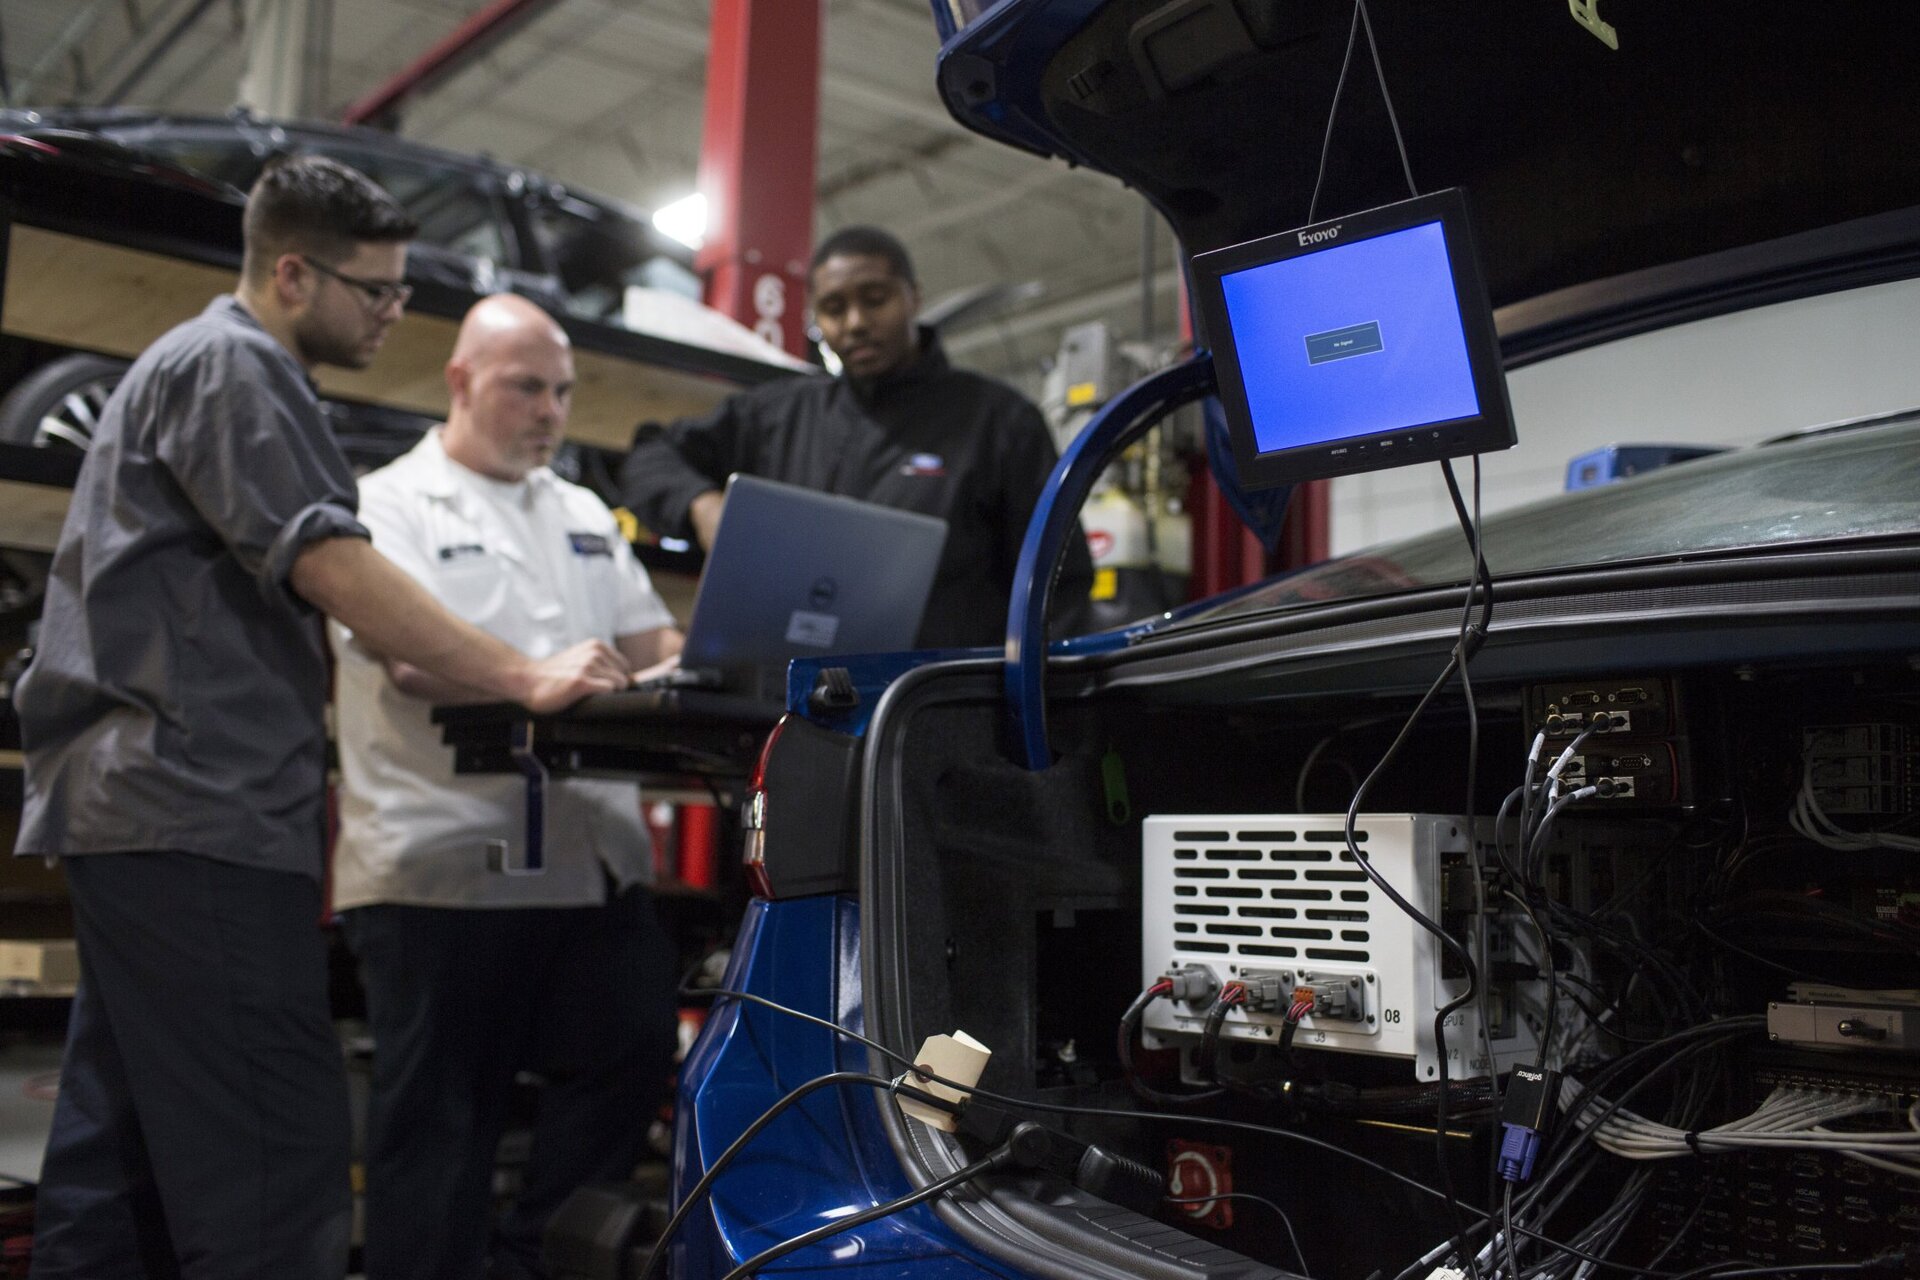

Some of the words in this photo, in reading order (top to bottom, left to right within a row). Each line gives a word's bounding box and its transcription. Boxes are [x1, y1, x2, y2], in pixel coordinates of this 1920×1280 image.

[1384, 1008, 1401, 1024] 08
[1247, 1026, 1260, 1037] J2
[1314, 1031, 1326, 1043] J3
